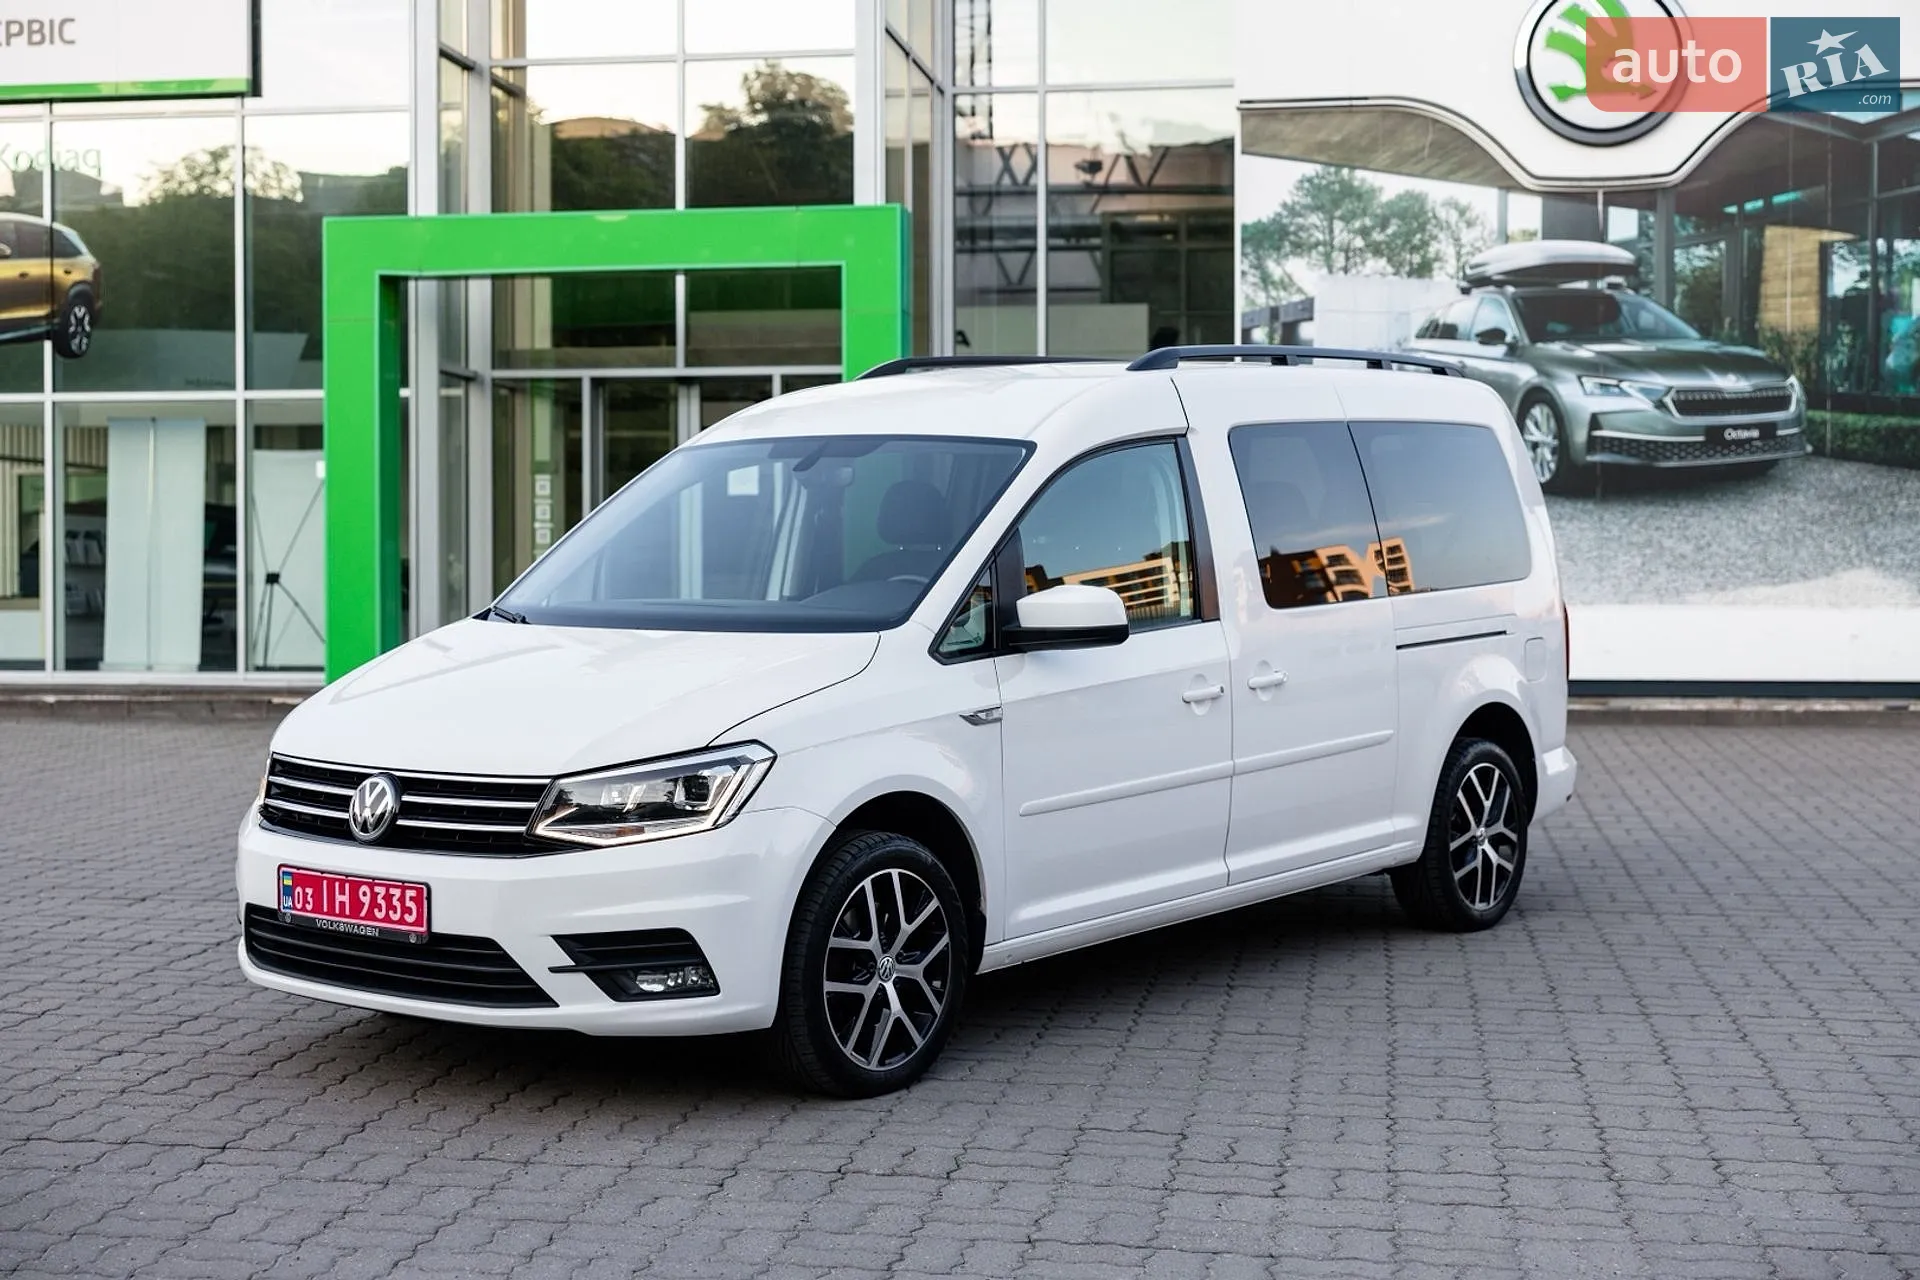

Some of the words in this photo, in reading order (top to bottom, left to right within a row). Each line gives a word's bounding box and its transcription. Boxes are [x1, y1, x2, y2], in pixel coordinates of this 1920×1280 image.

[0, 18, 76, 46] РВІС
[283, 895, 293, 908] UA
[294, 886, 314, 911] 03
[358, 884, 418, 924] 9335
[315, 918, 380, 937] VOLKSWAGEN
